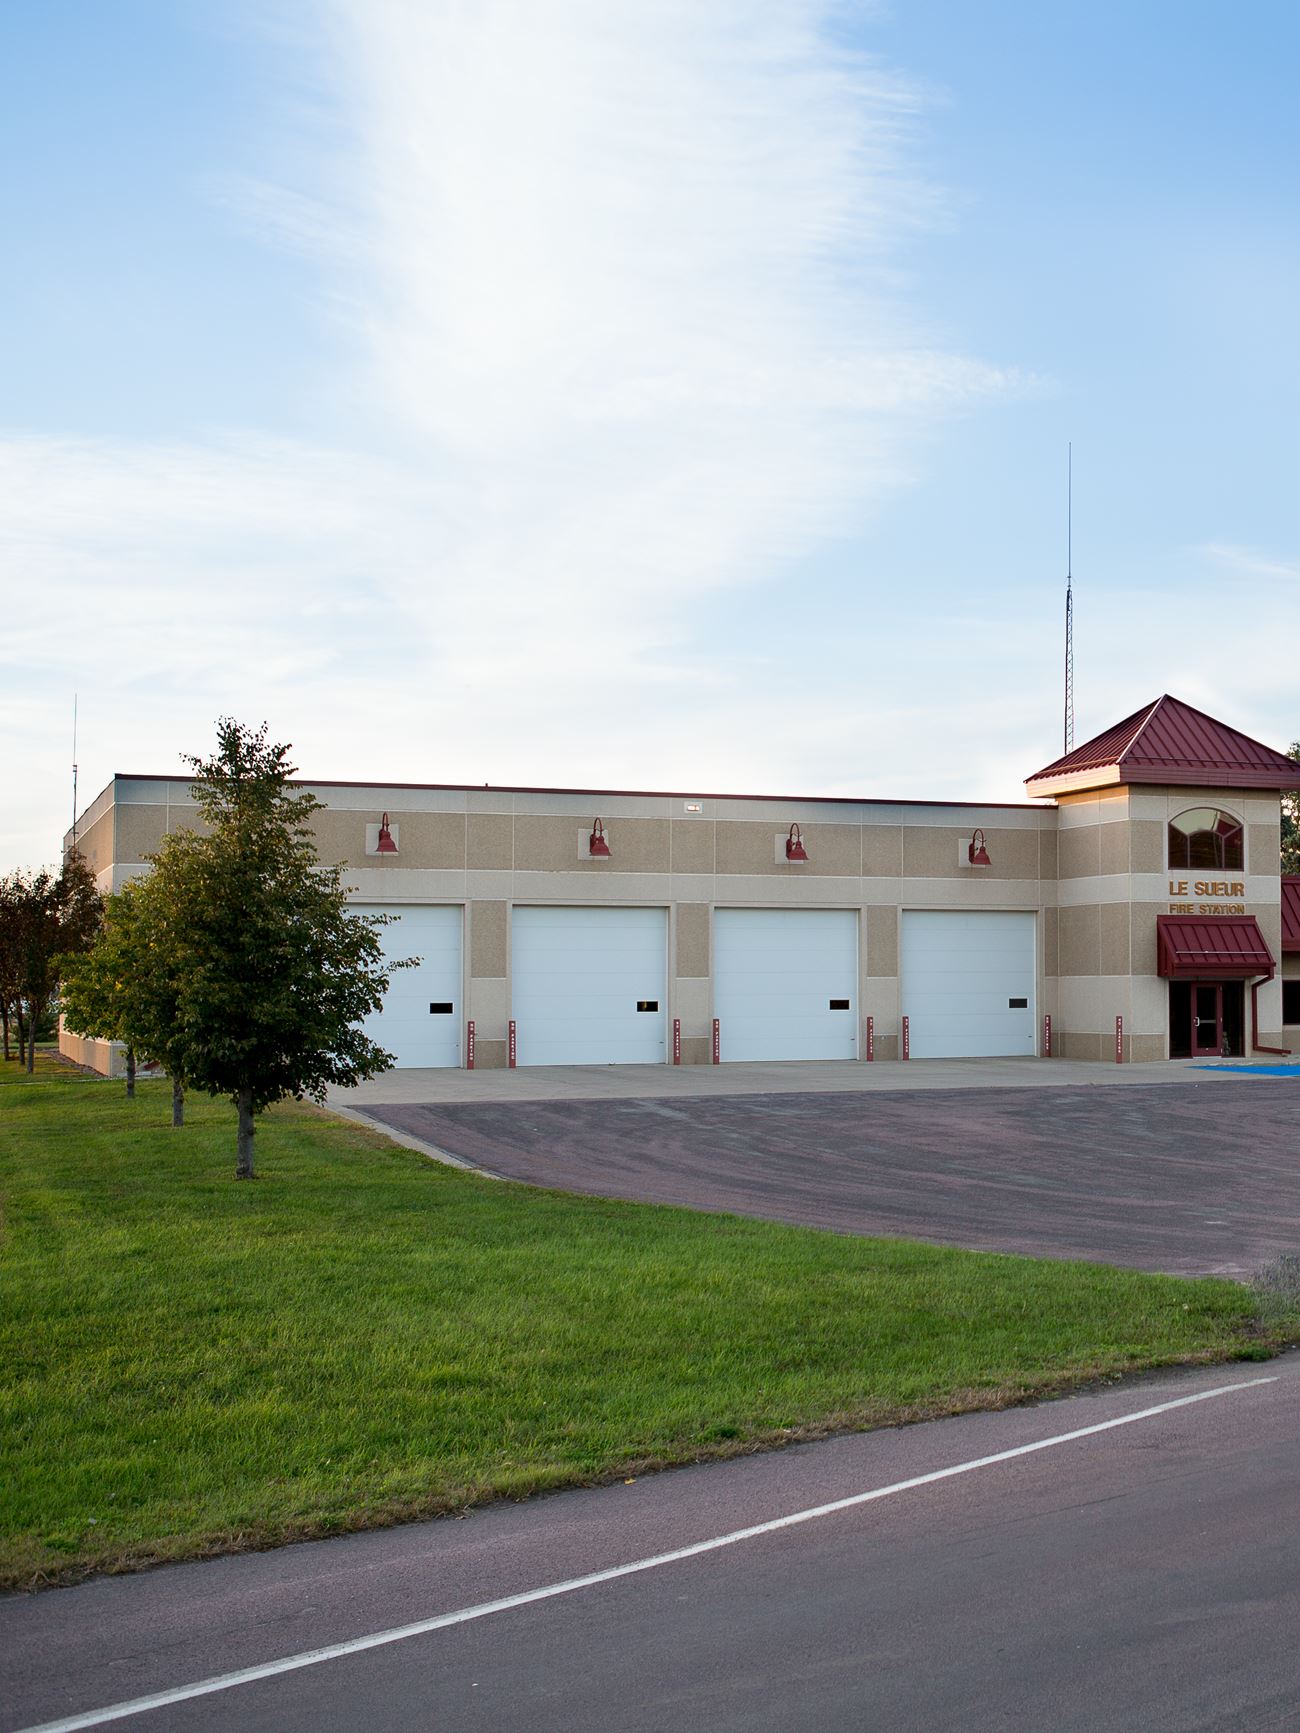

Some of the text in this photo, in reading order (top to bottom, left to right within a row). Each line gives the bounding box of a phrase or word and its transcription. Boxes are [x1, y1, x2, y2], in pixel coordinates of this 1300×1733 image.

[1169, 881, 1245, 897] LE SUEUR
[1169, 903, 1245, 915] FIRE STATION
